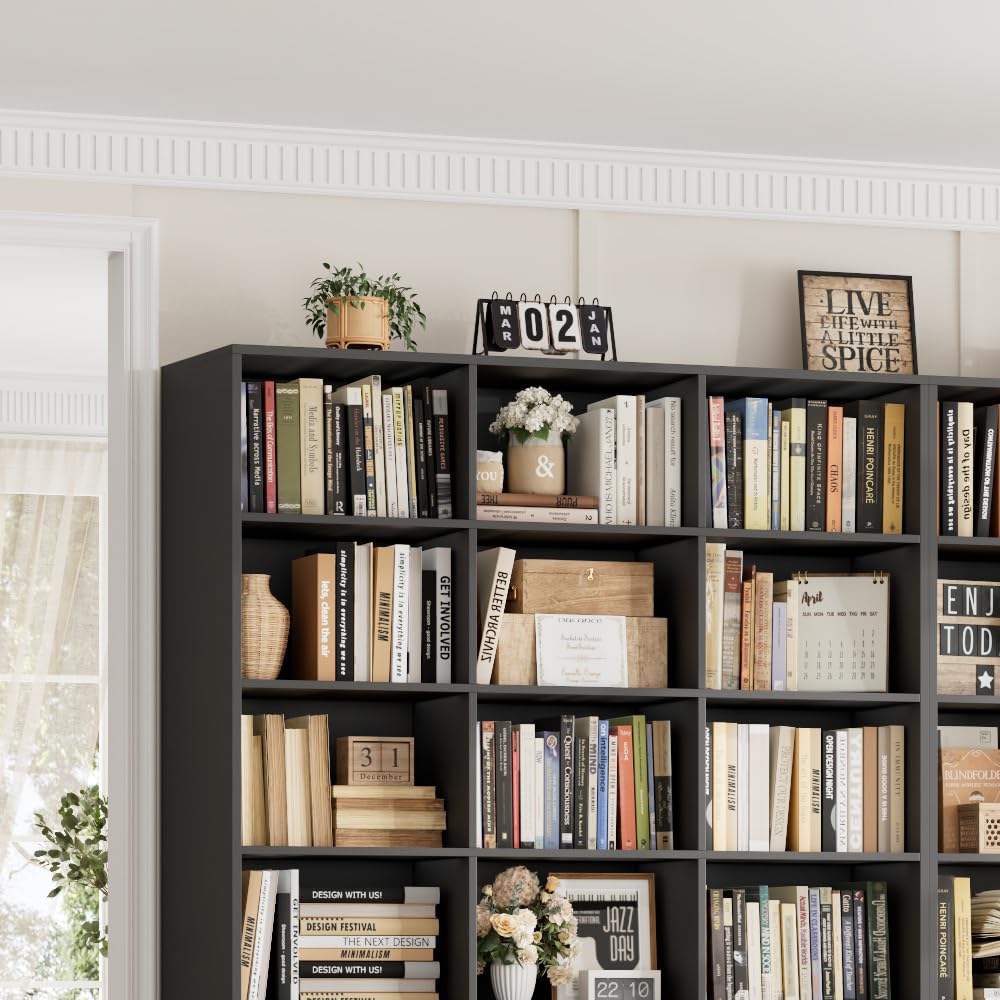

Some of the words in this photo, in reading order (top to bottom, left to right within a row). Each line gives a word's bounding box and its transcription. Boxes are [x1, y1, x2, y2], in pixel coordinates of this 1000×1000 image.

[826, 289, 892, 316] LIVE
[500, 306, 511, 340] MAR
[525, 308, 576, 342] 02
[589, 311, 601, 345] JAN
[820, 315, 859, 330] LIFE
[861, 319, 898, 329] WITH
[821, 330, 834, 344] A
[838, 331, 898, 346] LITTLE
[822, 345, 900, 372] SPICE
[308, 406, 318, 426] Media
[309, 428, 318, 442] and
[866, 427, 874, 455] HENRI
[307, 444, 318, 473] Symbols
[830, 464, 838, 493] CHAOS
[865, 457, 875, 504] POINCARÉ
[398, 553, 406, 590] simplicity
[440, 576, 450, 598] GET
[802, 591, 823, 607] April
[377, 592, 391, 642] MINIMALISM
[396, 610, 405, 650] everything
[440, 601, 450, 660] INVOLVED
[397, 652, 402, 662] we
[825, 736, 833, 753] OPEN
[599, 738, 607, 792] intelligence
[825, 754, 833, 778] DESIGN
[728, 764, 736, 811] MINIMALISM
[812, 768, 820, 814] MINIMALISM
[825, 779, 833, 800] NIGHT
[312, 890, 342, 899] DESIGN
[345, 891, 366, 899] WITH
[369, 891, 382, 899] US!
[843, 895, 851, 912] Gatto
[307, 923, 336, 931] DESIGN
[340, 923, 376, 931] FESTIVAL
[603, 906, 634, 933] JAZZ
[240, 916, 255, 967] MINIMALISM
[344, 937, 362, 946] THE
[365, 938, 389, 946] NEXT
[393, 938, 429, 946] DESIGN
[610, 936, 634, 962] DAY
[843, 926, 852, 949] Different
[341, 950, 390, 958] MINIMALISM
[312, 966, 342, 974] DESIGN
[345, 966, 366, 974] WITH
[369, 966, 382, 974] US!
[597, 982, 619, 998] 22
[629, 982, 649, 997] 10
